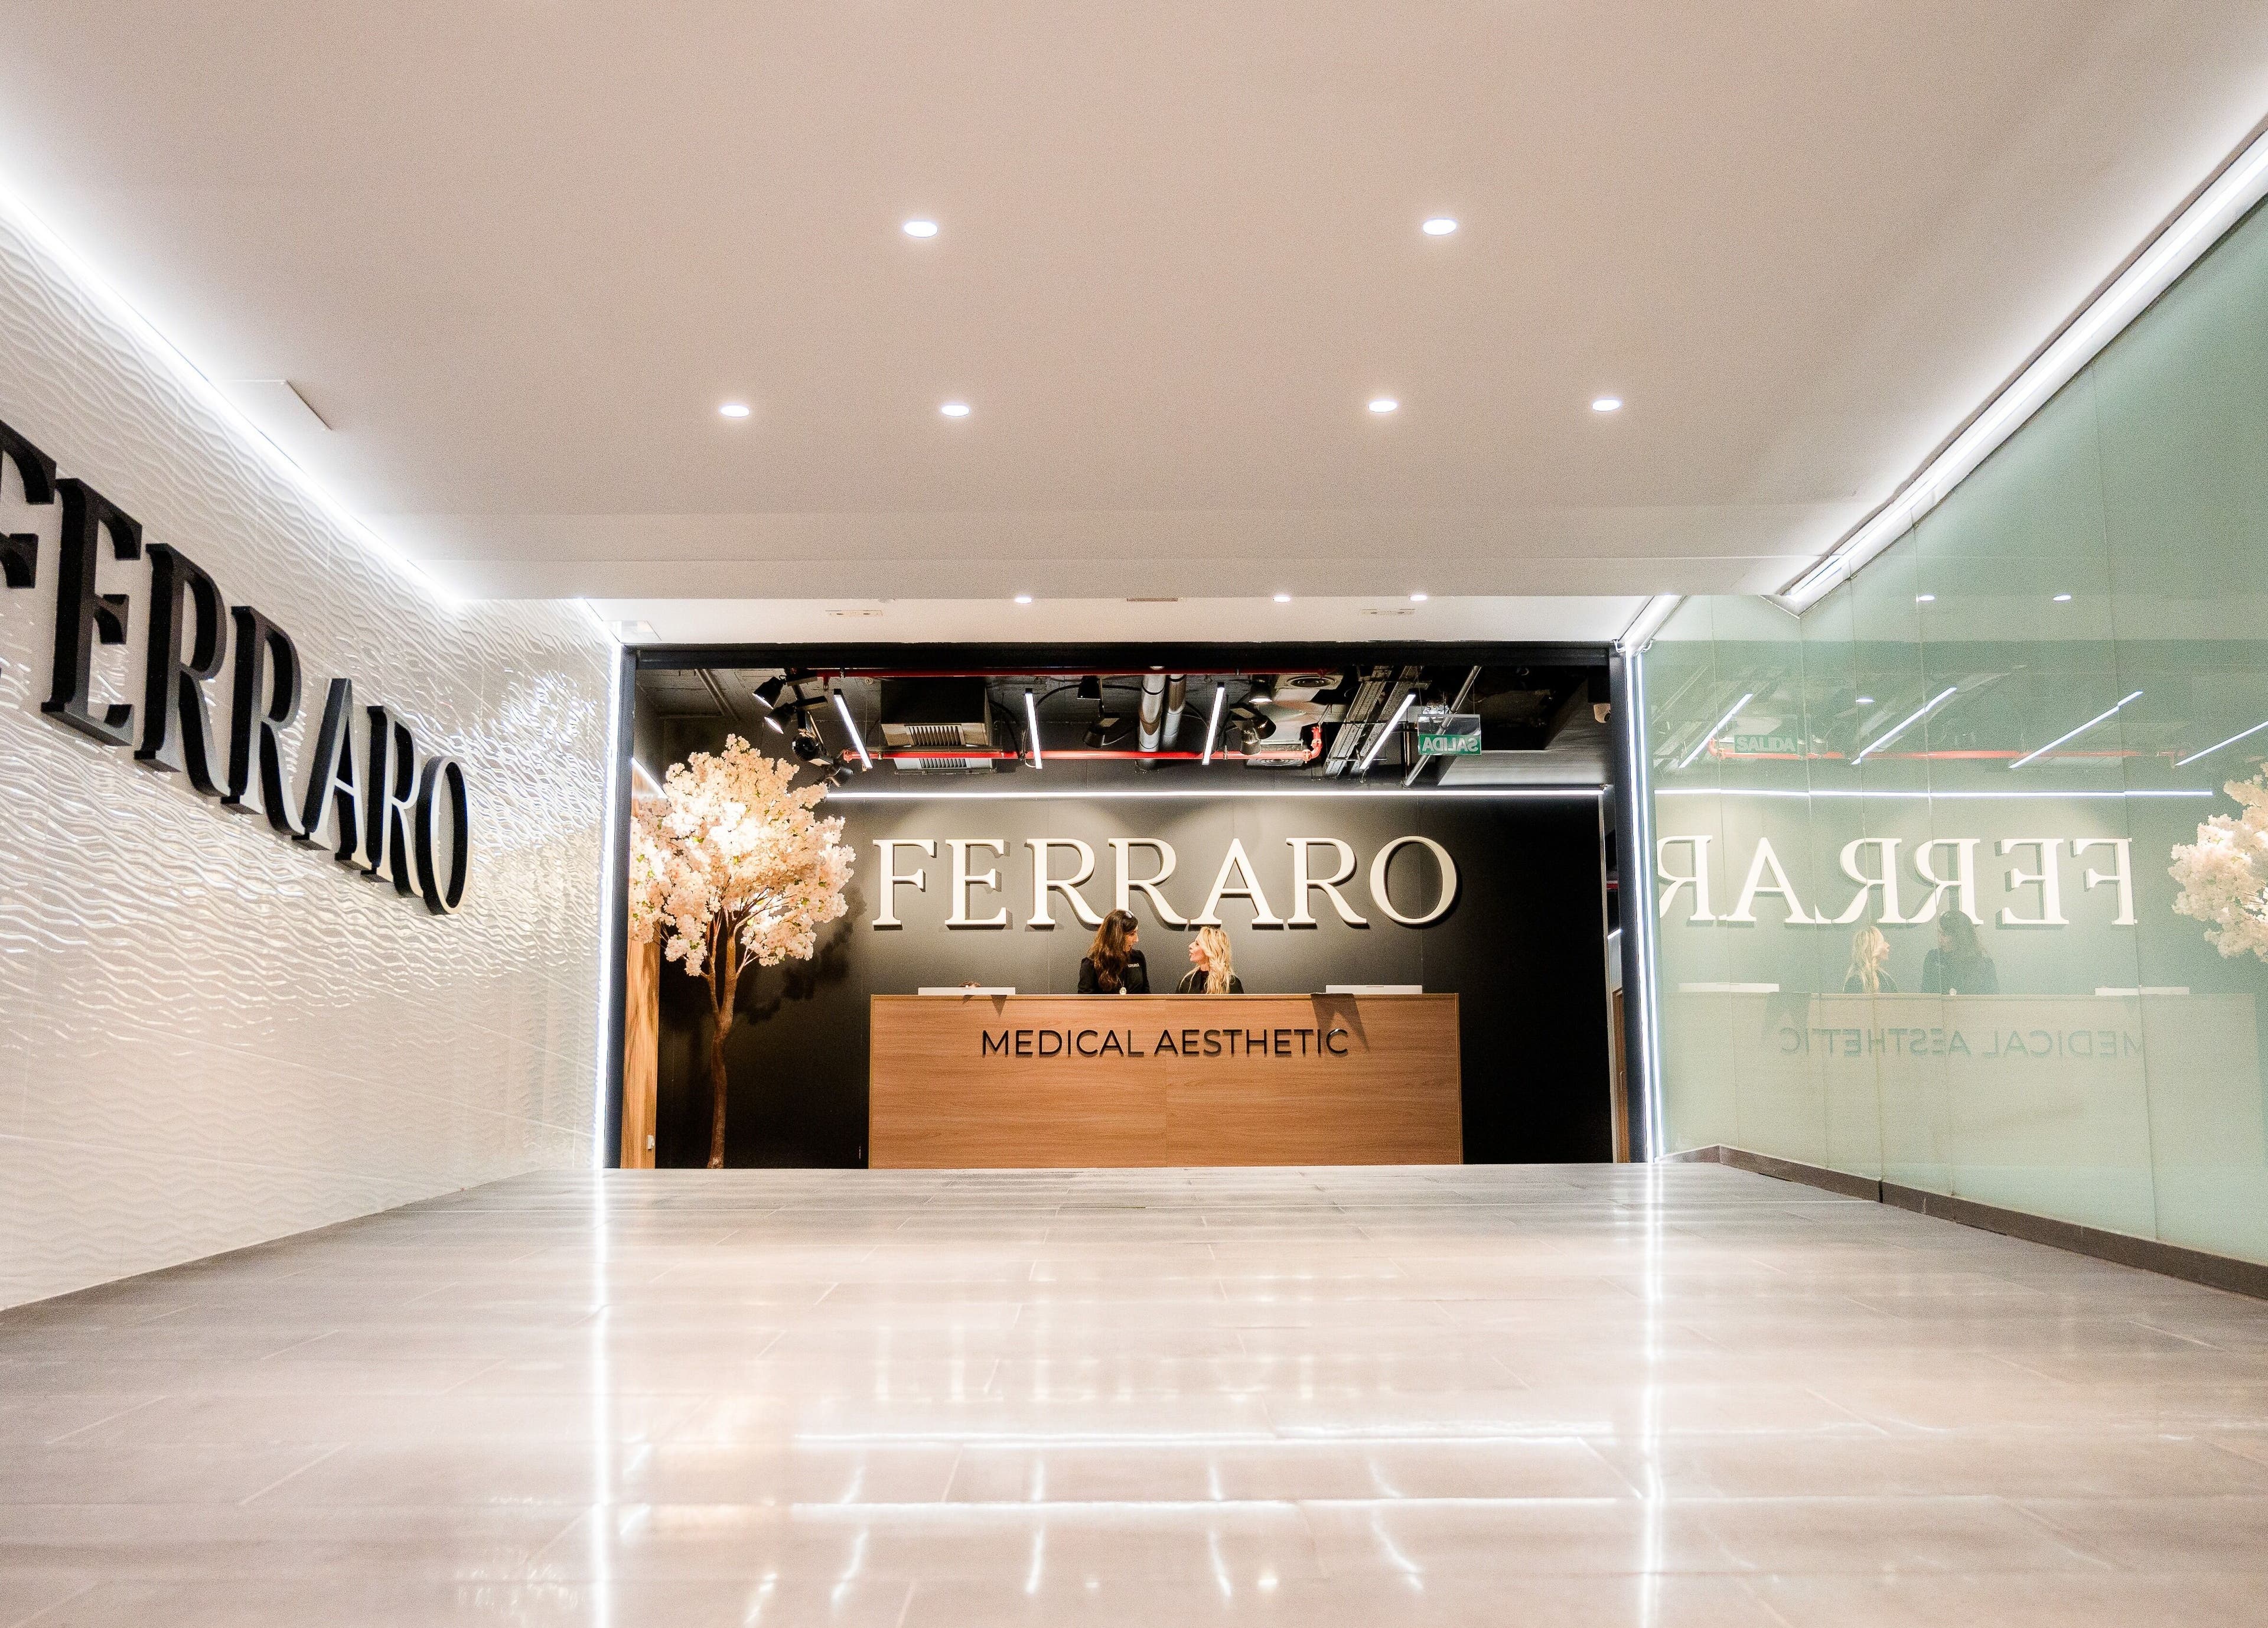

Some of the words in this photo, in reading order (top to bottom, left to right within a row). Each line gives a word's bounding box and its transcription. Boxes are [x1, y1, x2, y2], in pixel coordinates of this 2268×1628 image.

[1736, 737, 1796, 751] SALIDA
[872, 835, 1459, 928] FERRARO
[982, 1029, 1145, 1057] MEDICAL
[1153, 1028, 1348, 1057] AESTHETIC
